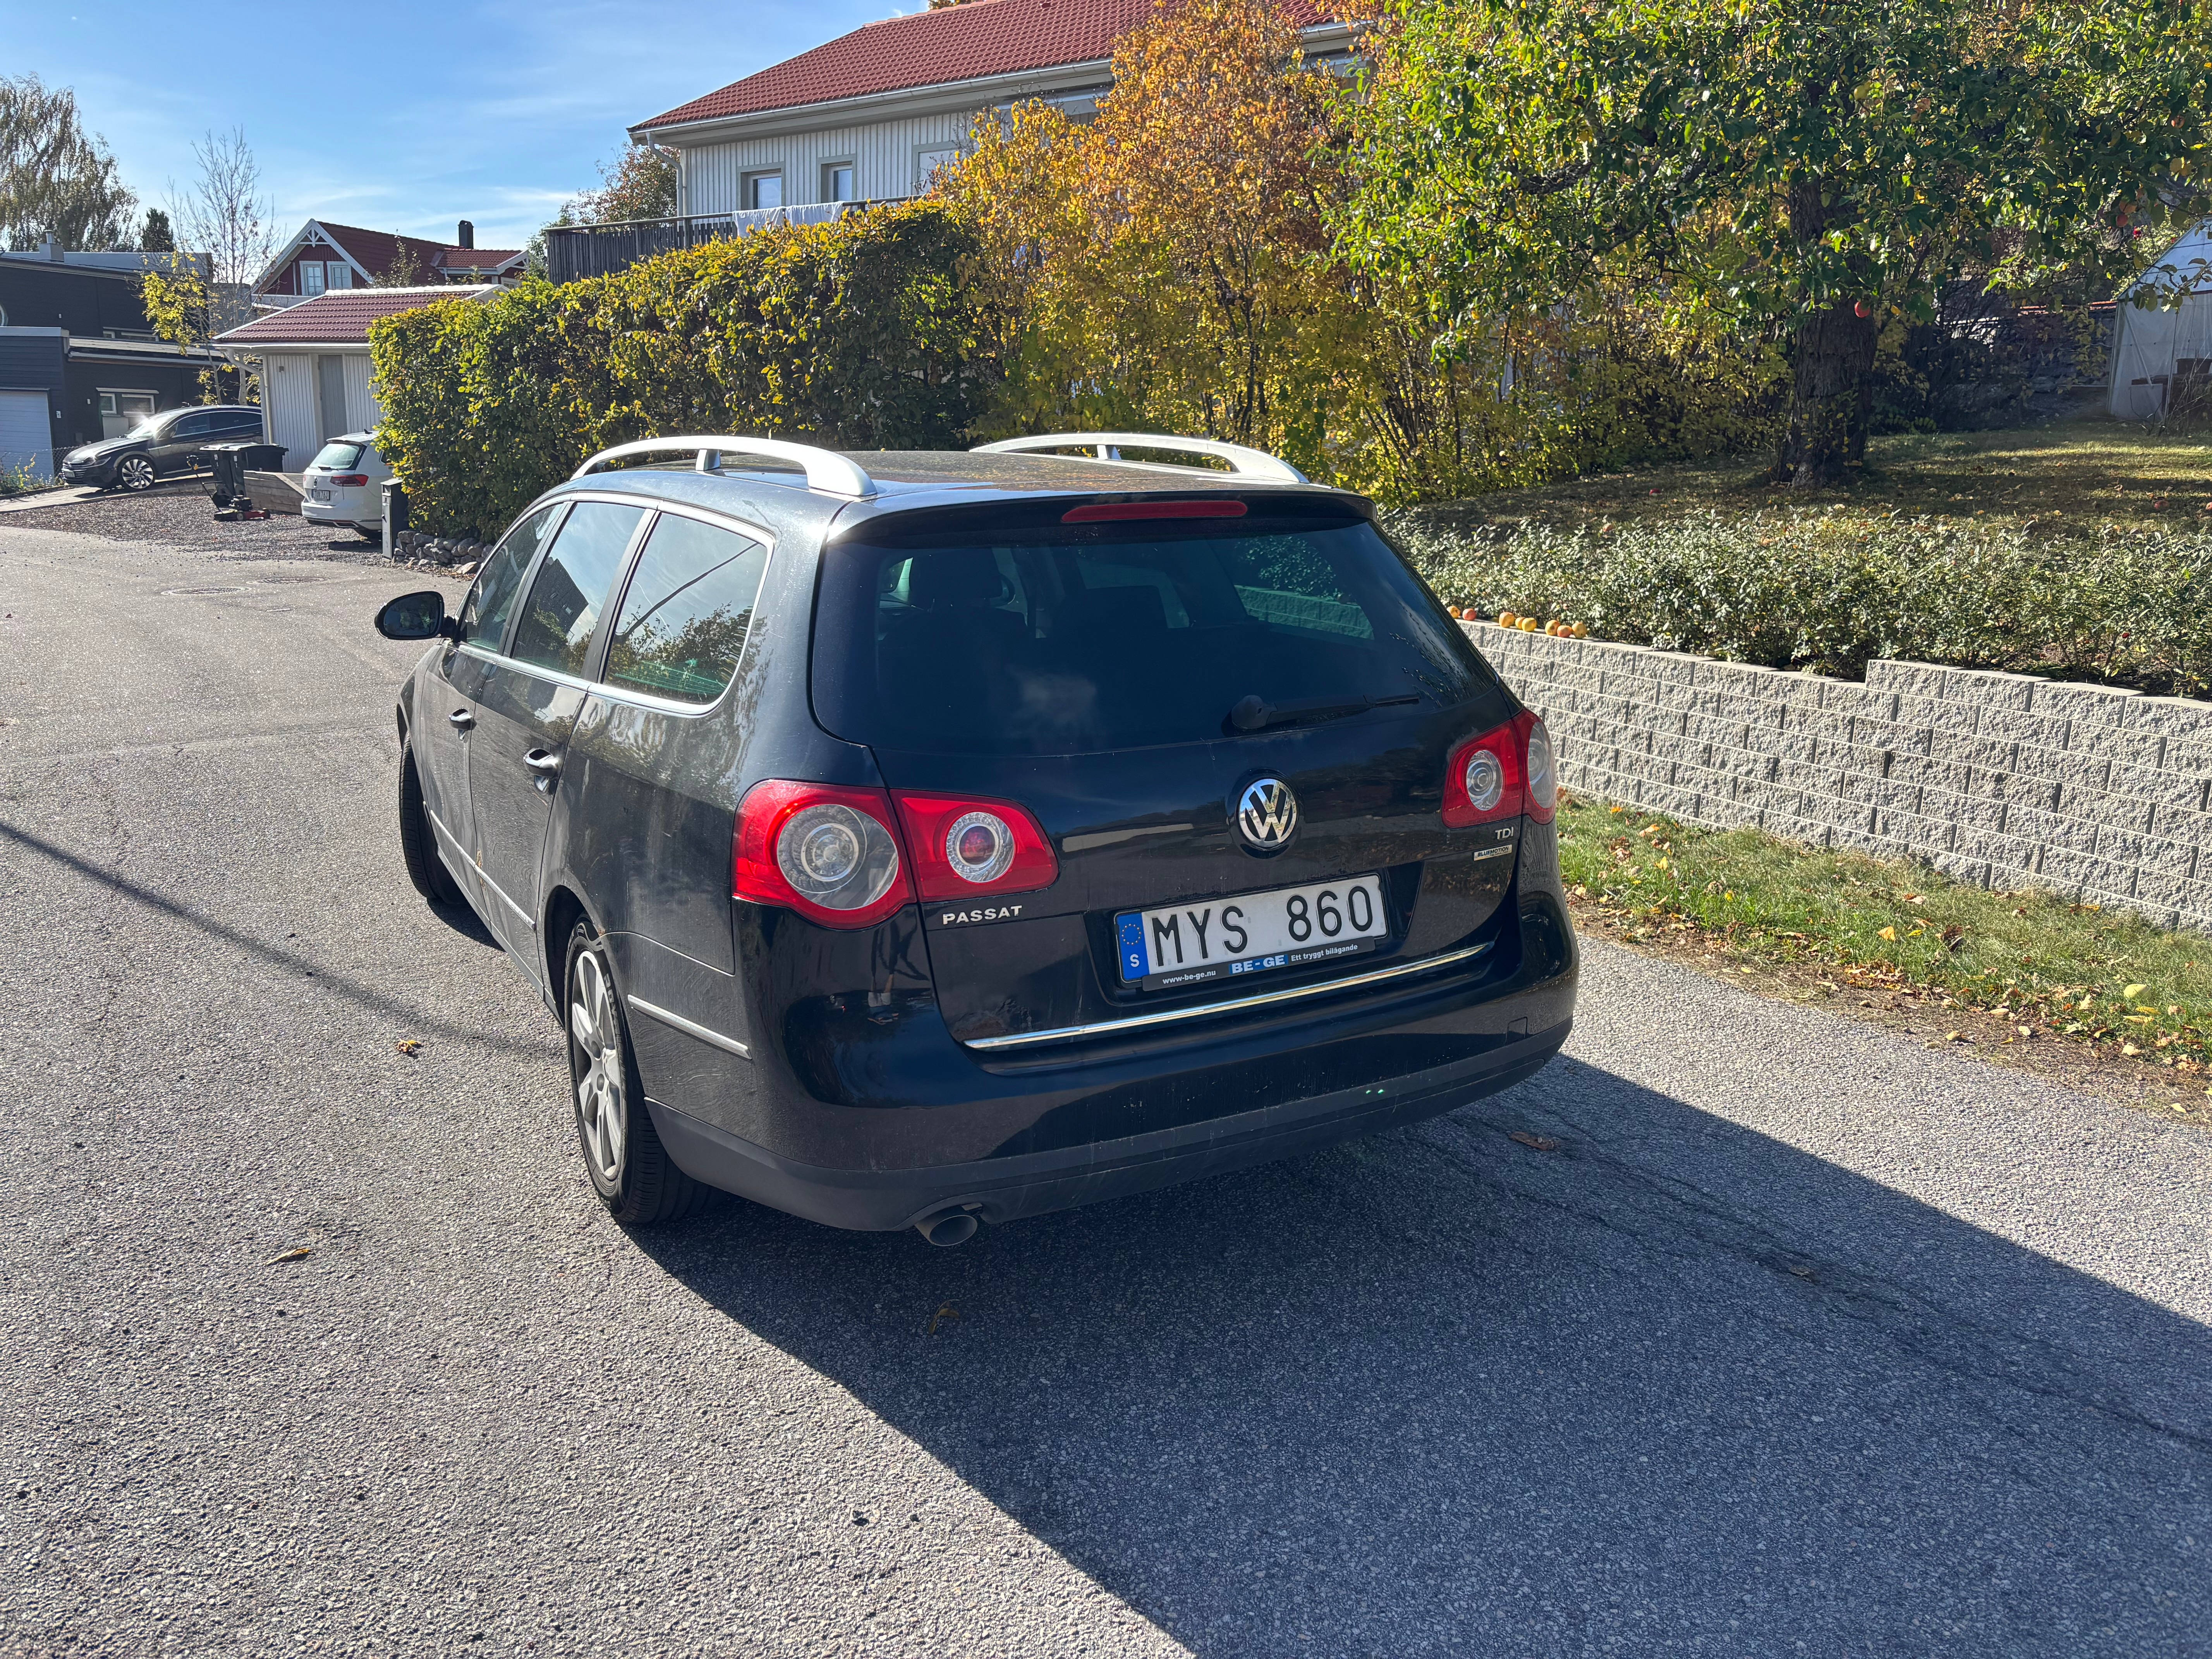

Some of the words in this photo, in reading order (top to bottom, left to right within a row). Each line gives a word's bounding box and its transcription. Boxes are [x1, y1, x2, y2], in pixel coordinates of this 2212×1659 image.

[1495, 826, 1514, 840] TDI
[1477, 846, 1509, 857] BLUEMOTION
[943, 905, 1022, 925] PASSAT
[1152, 905, 1248, 967] MYS
[1286, 885, 1373, 942] 860
[1130, 954, 1140, 967] S
[1231, 954, 1286, 974] BE-GE
[1302, 950, 1325, 960] tryggt
[1325, 943, 1358, 956] bilägande
